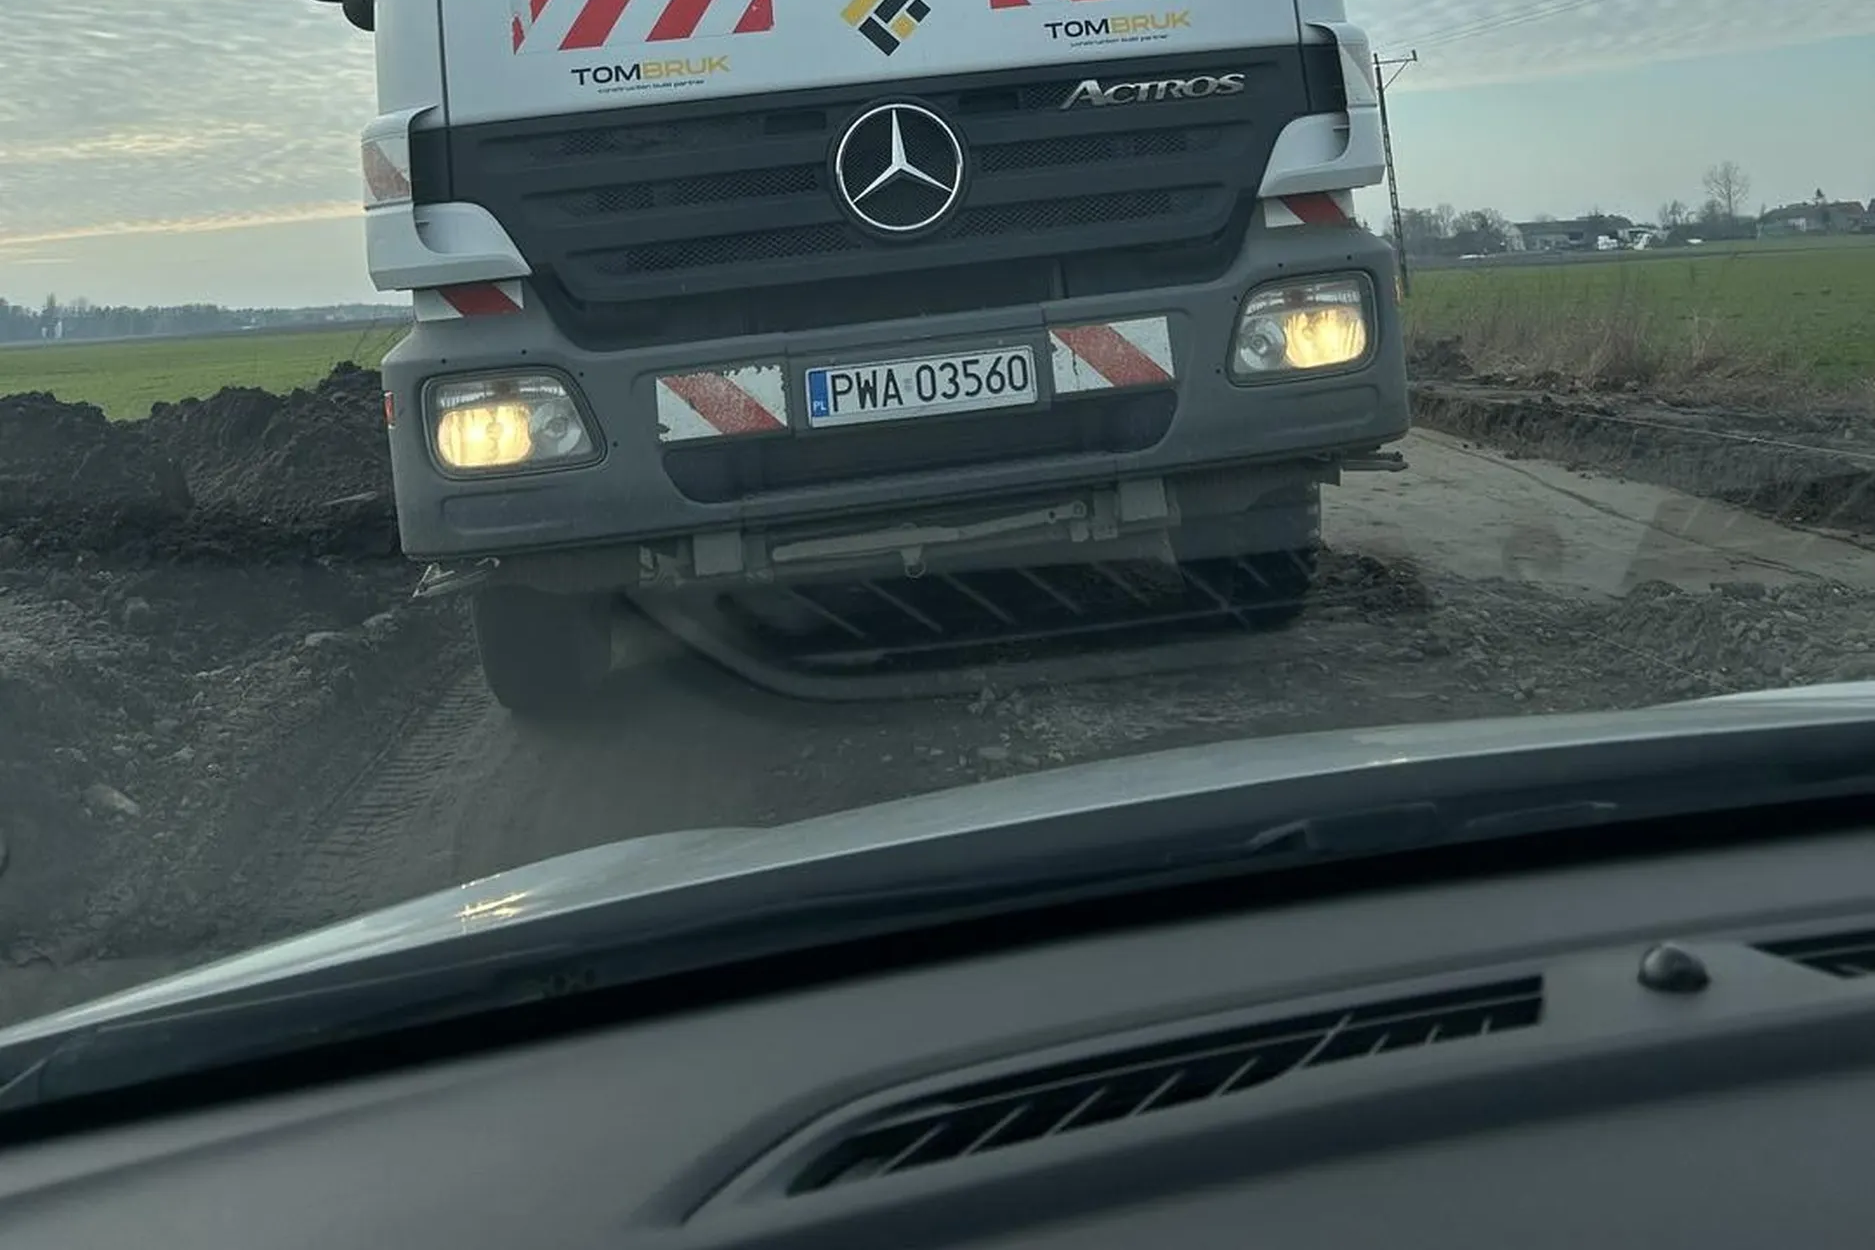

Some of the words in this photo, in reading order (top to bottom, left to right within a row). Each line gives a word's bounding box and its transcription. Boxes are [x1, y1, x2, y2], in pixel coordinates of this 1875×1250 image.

[1044, 10, 1192, 39] TOMBRUK
[570, 54, 731, 86] TOMBRUK
[830, 368, 904, 413] PWA
[915, 354, 1029, 402] 03560
[812, 400, 827, 412] PL
